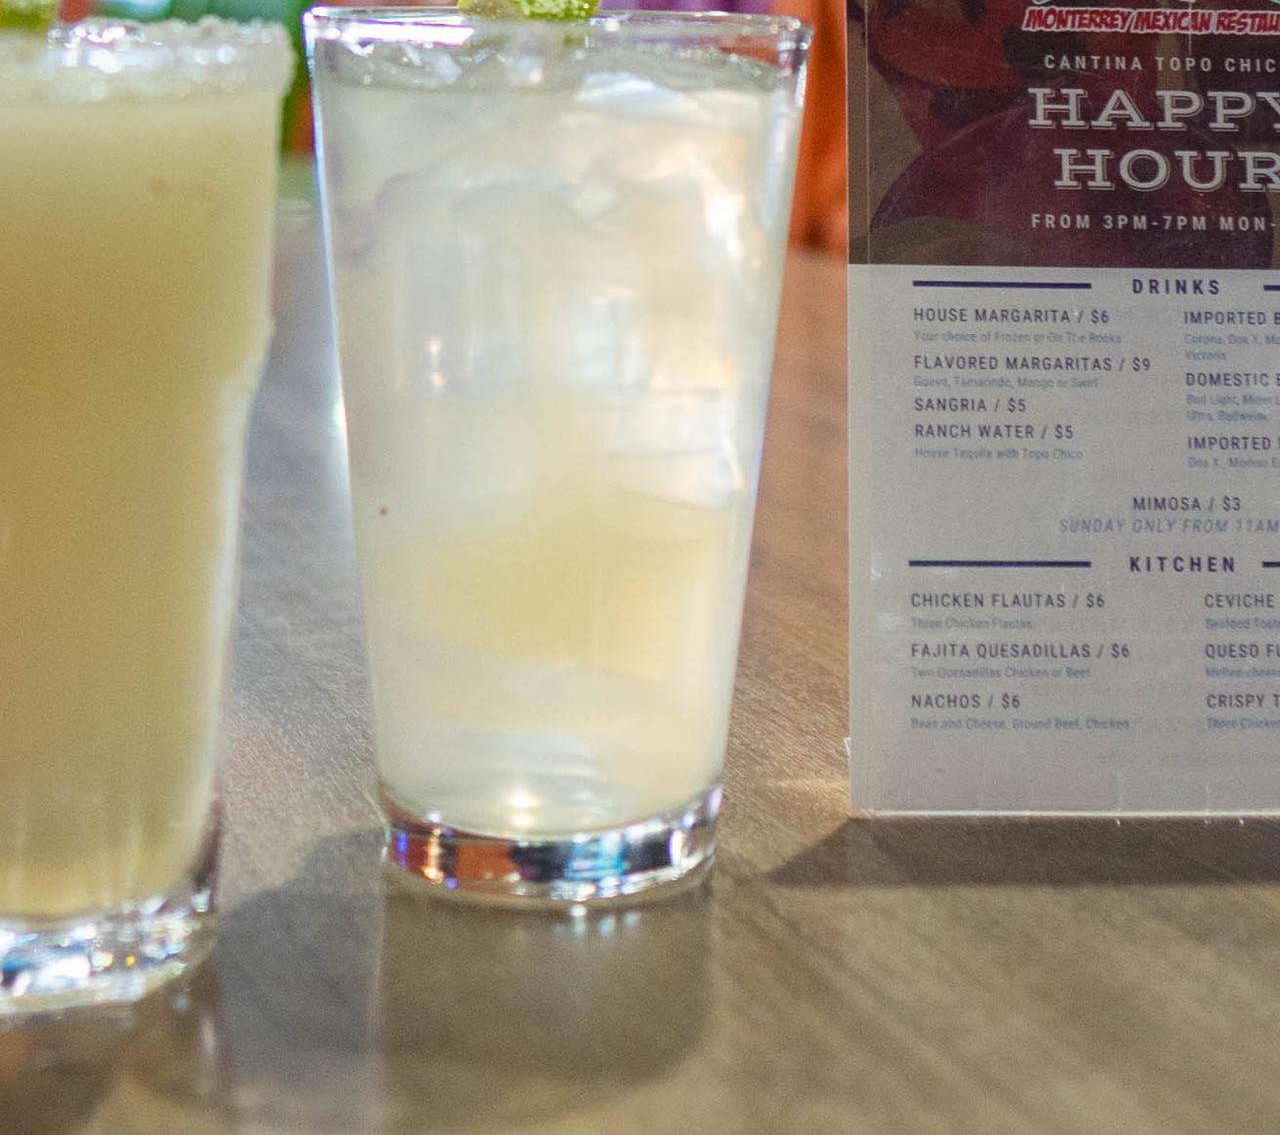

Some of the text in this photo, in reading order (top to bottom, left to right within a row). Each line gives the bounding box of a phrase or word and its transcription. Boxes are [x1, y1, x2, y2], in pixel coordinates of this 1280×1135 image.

[1022, 7, 1132, 32] MONTERREY
[1131, 10, 1212, 34] MEXICAN
[1044, 55, 1143, 71] CANTINA
[1155, 56, 1212, 72] TOPO
[1032, 214, 1090, 229] FROM
[1103, 215, 1206, 231] 3PM-7PM
[1132, 279, 1220, 295] DRINKS
[913, 308, 967, 322] HOUSE
[975, 309, 1070, 323] MARGARITA
[1091, 310, 1109, 324] $6
[1184, 311, 1267, 325] IMPORTED
[914, 356, 998, 370] FLAVORED
[1006, 357, 1112, 371] MARGARITAS
[1132, 357, 1151, 372] $9
[1186, 373, 1269, 386] DOMESTIC
[914, 398, 987, 412] SANGRIA
[1007, 398, 1026, 413] $5
[915, 425, 971, 438] RANCH
[978, 425, 1034, 439] WATER
[1054, 425, 1073, 439] $5
[1188, 437, 1271, 450] IMPORTED
[1133, 497, 1201, 511] MIMOSA
[1222, 496, 1241, 511] $3
[1059, 519, 1125, 532] SUNDAY
[1132, 519, 1174, 532] ONLY
[1182, 520, 1228, 532] FROM
[1130, 557, 1235, 572] KITCHEN
[911, 593, 984, 607] CHICKEN
[991, 594, 1065, 608] FLAUTAS
[1086, 593, 1105, 609] $6
[1204, 594, 1274, 608] CEVICHE
[912, 644, 969, 658] FAJITA
[977, 644, 1091, 658] QUESADILLAS
[1111, 644, 1130, 659] $6
[1206, 644, 1260, 659] QUESO
[912, 695, 981, 708] NACHOS
[1002, 694, 1020, 709] $6
[1206, 695, 1265, 708] CRISPY
